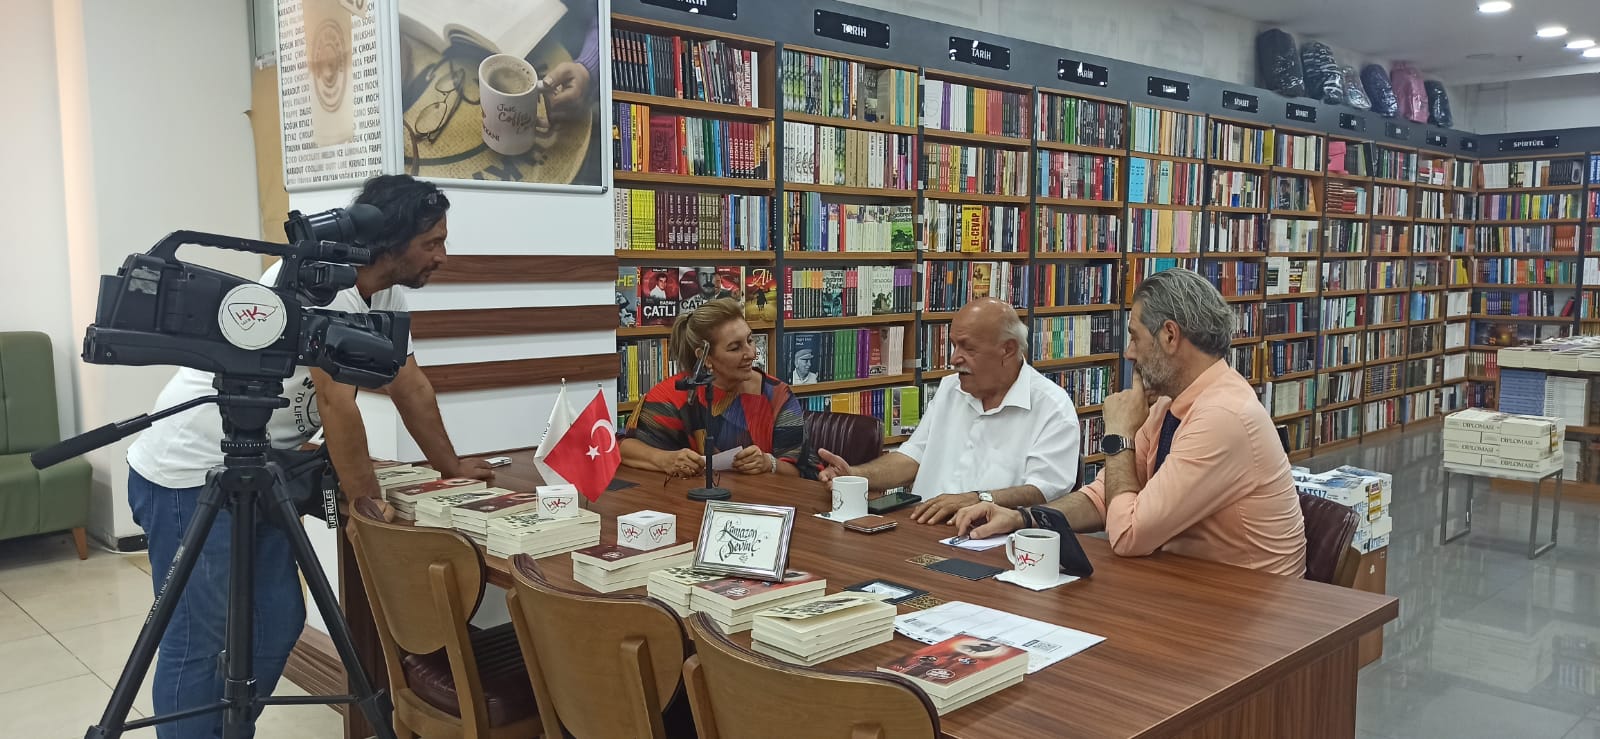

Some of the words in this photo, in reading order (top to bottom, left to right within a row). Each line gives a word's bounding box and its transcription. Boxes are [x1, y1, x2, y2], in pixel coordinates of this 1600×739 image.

[842, 24, 867, 38] TARİH
[971, 47, 991, 60] TARİH
[235, 305, 267, 321] HK
[643, 305, 677, 320] ÇATLI
[294, 391, 306, 403] TO
[293, 405, 305, 425] LIFE
[326, 489, 335, 514] RULES
